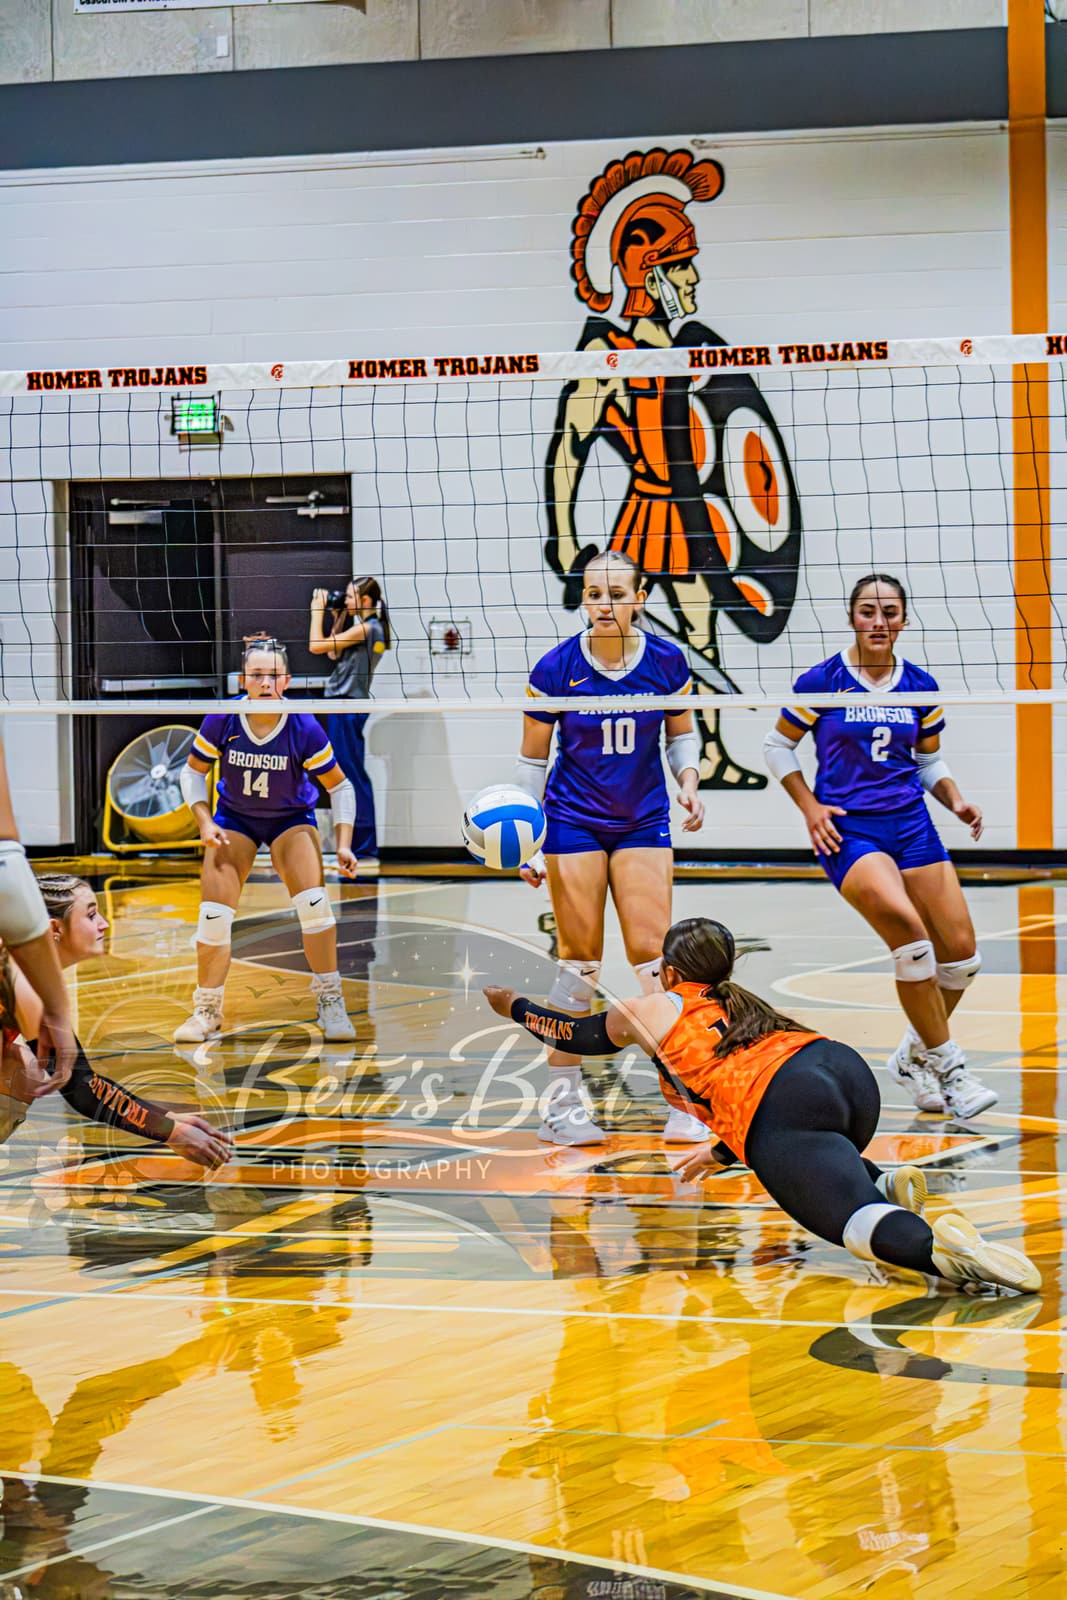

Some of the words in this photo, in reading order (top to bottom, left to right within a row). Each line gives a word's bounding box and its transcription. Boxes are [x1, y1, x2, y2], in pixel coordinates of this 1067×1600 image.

[688, 346, 771, 368] HOMER
[778, 340, 888, 364] TROJANS
[1046, 335, 1067, 356] H
[27, 370, 102, 390] HOMER
[108, 366, 207, 387] TROJANS
[348, 359, 427, 378] HOMER
[434, 354, 539, 376] TROJANS
[844, 705, 914, 724] BRONSON
[601, 717, 636, 755] 10
[871, 726, 892, 762] 2
[228, 749, 288, 771] BRONSON
[242, 769, 269, 798] 14
[524, 1010, 575, 1041] TROJANS
